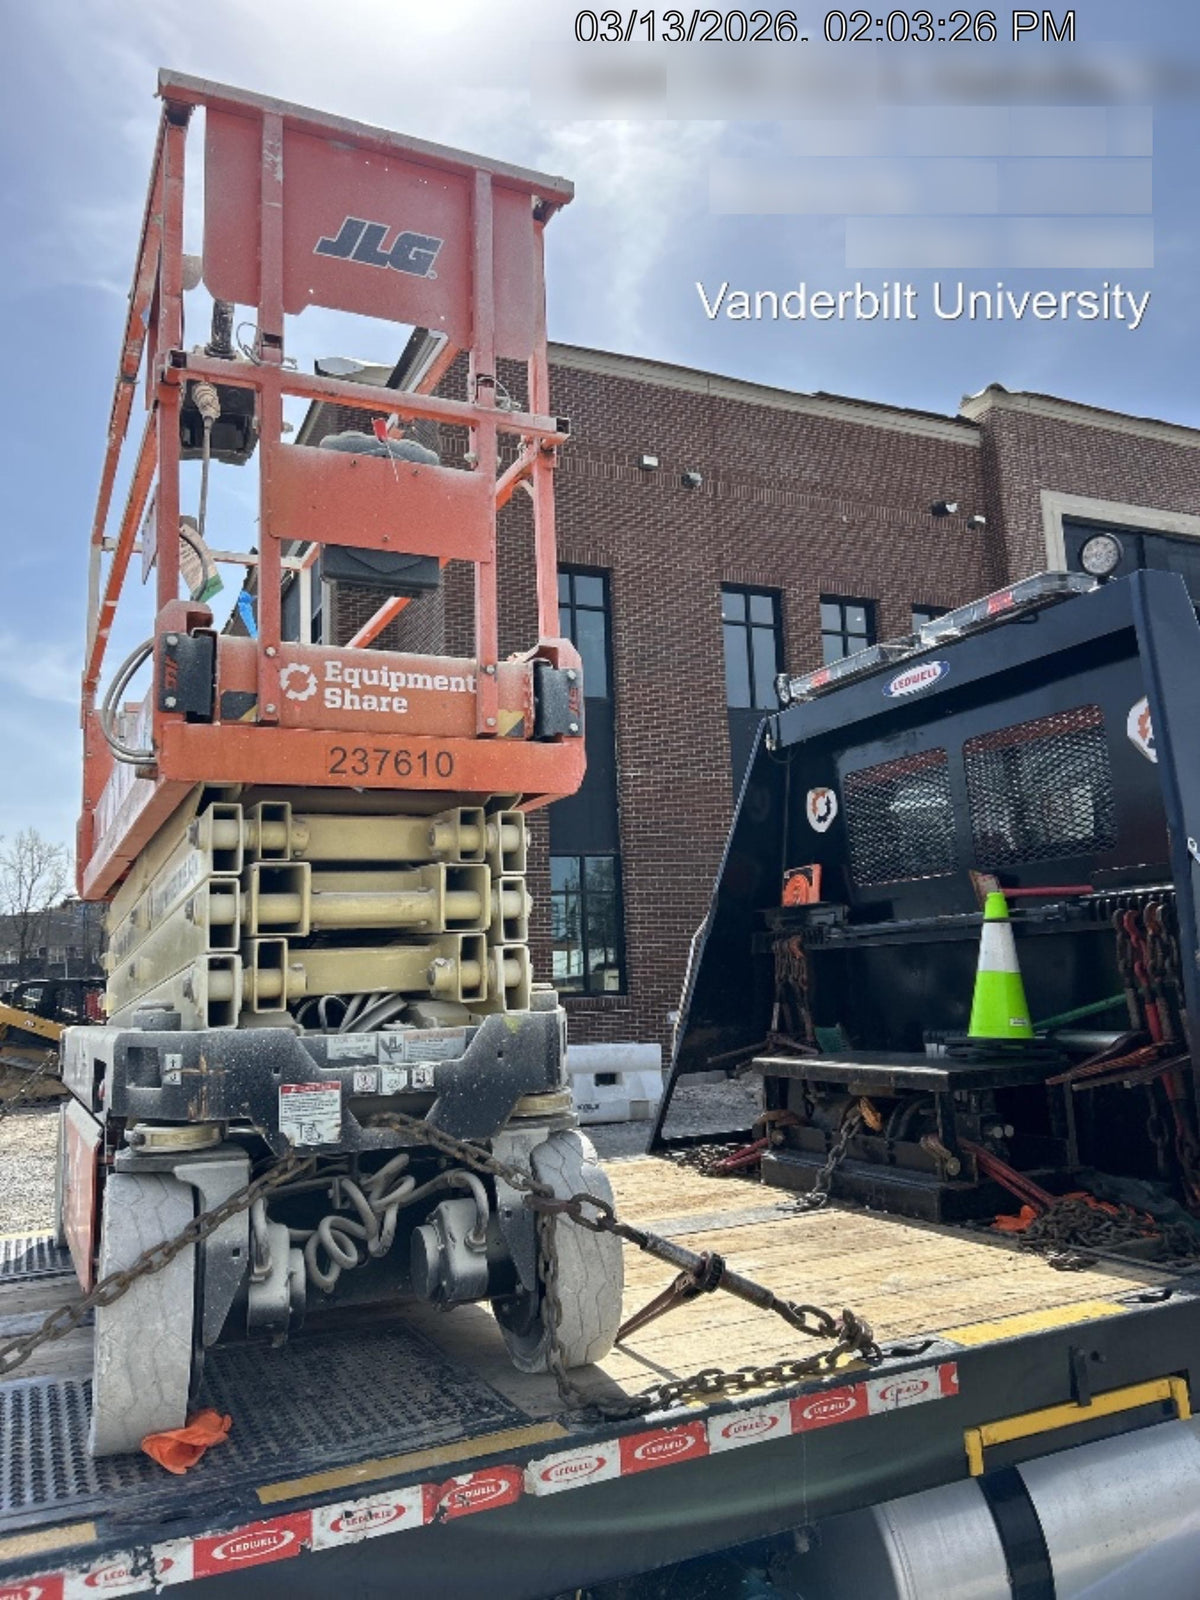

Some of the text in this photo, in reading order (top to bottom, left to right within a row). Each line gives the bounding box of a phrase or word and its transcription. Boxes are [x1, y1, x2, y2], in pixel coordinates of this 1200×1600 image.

[313, 216, 445, 279] JLG
[324, 660, 477, 694] Equipment
[893, 667, 938, 690] LEDWELL
[324, 687, 408, 714] Share
[329, 746, 454, 778] 237610
[230, 1536, 278, 1554] LEDWELL
